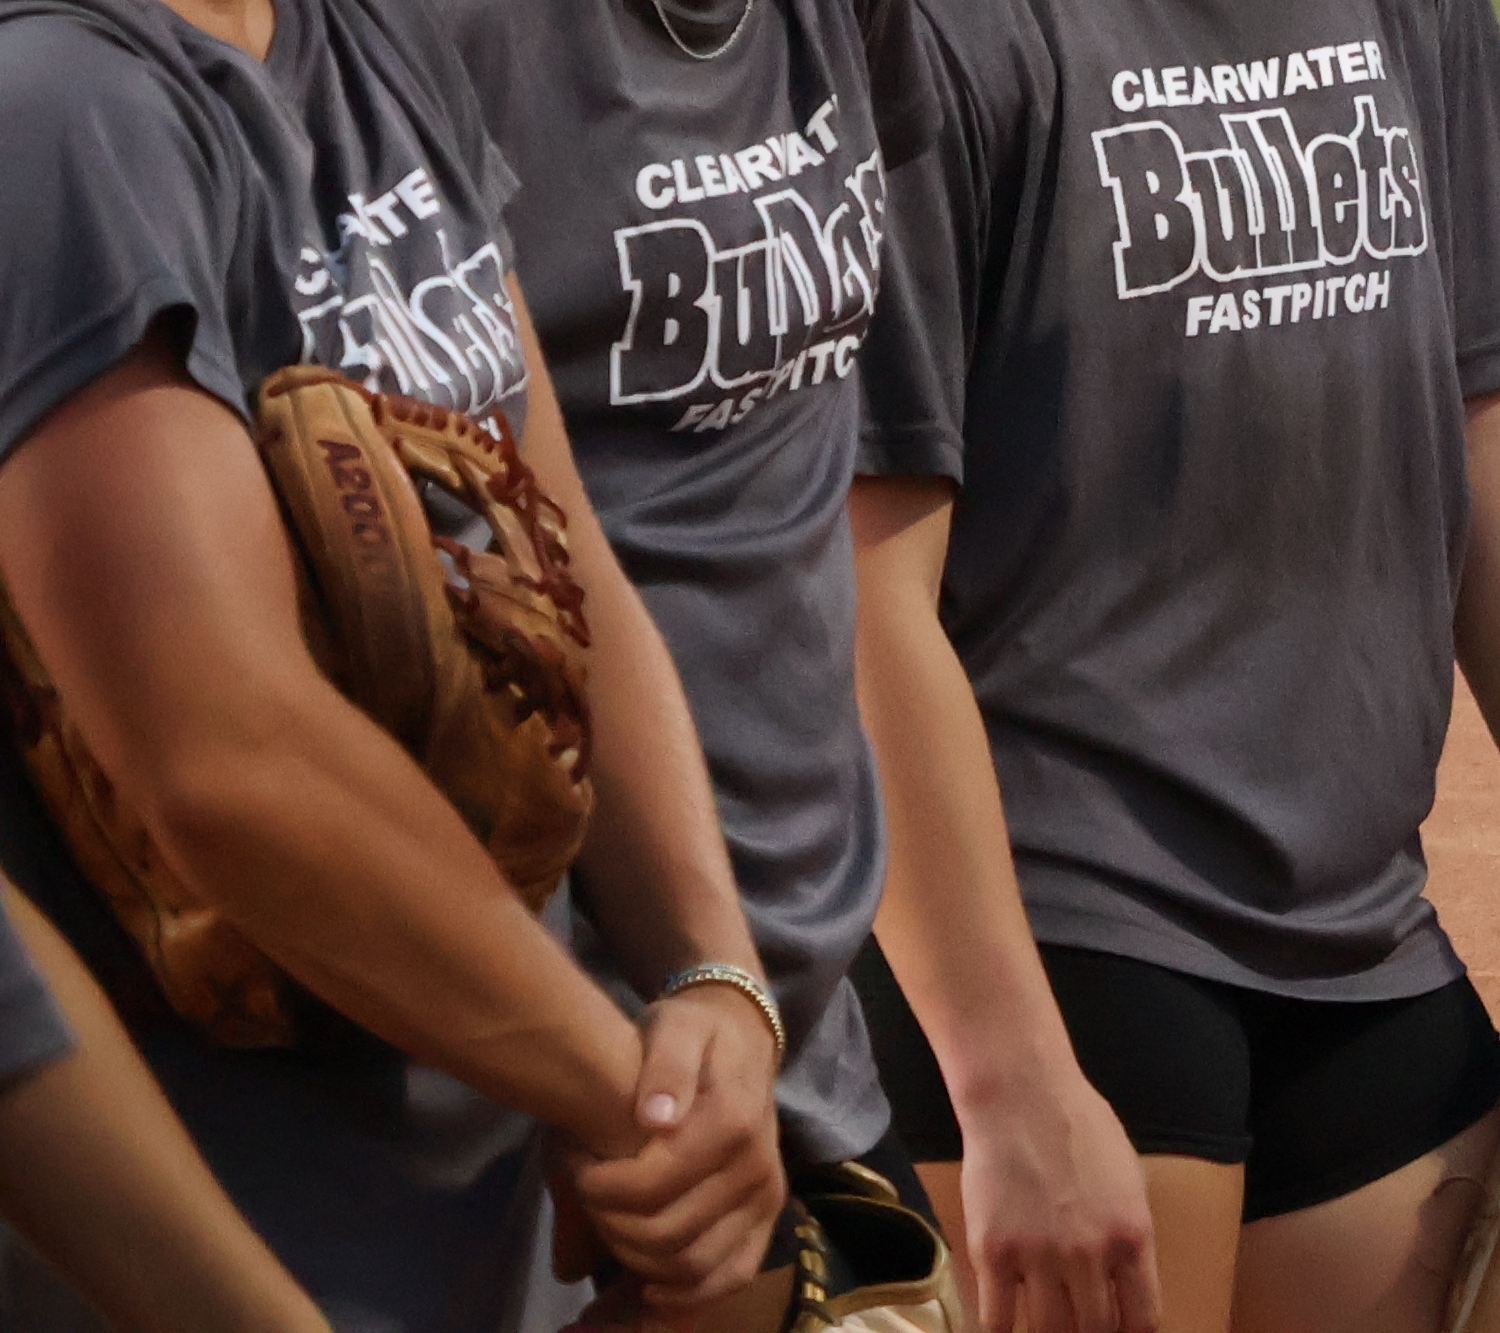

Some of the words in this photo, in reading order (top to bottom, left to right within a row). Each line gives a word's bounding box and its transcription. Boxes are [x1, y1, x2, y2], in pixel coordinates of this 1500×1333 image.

[1111, 41, 1386, 112] CLEARWATER
[1092, 95, 1429, 299] Bullets
[1186, 270, 1390, 337] FASTPITCH
